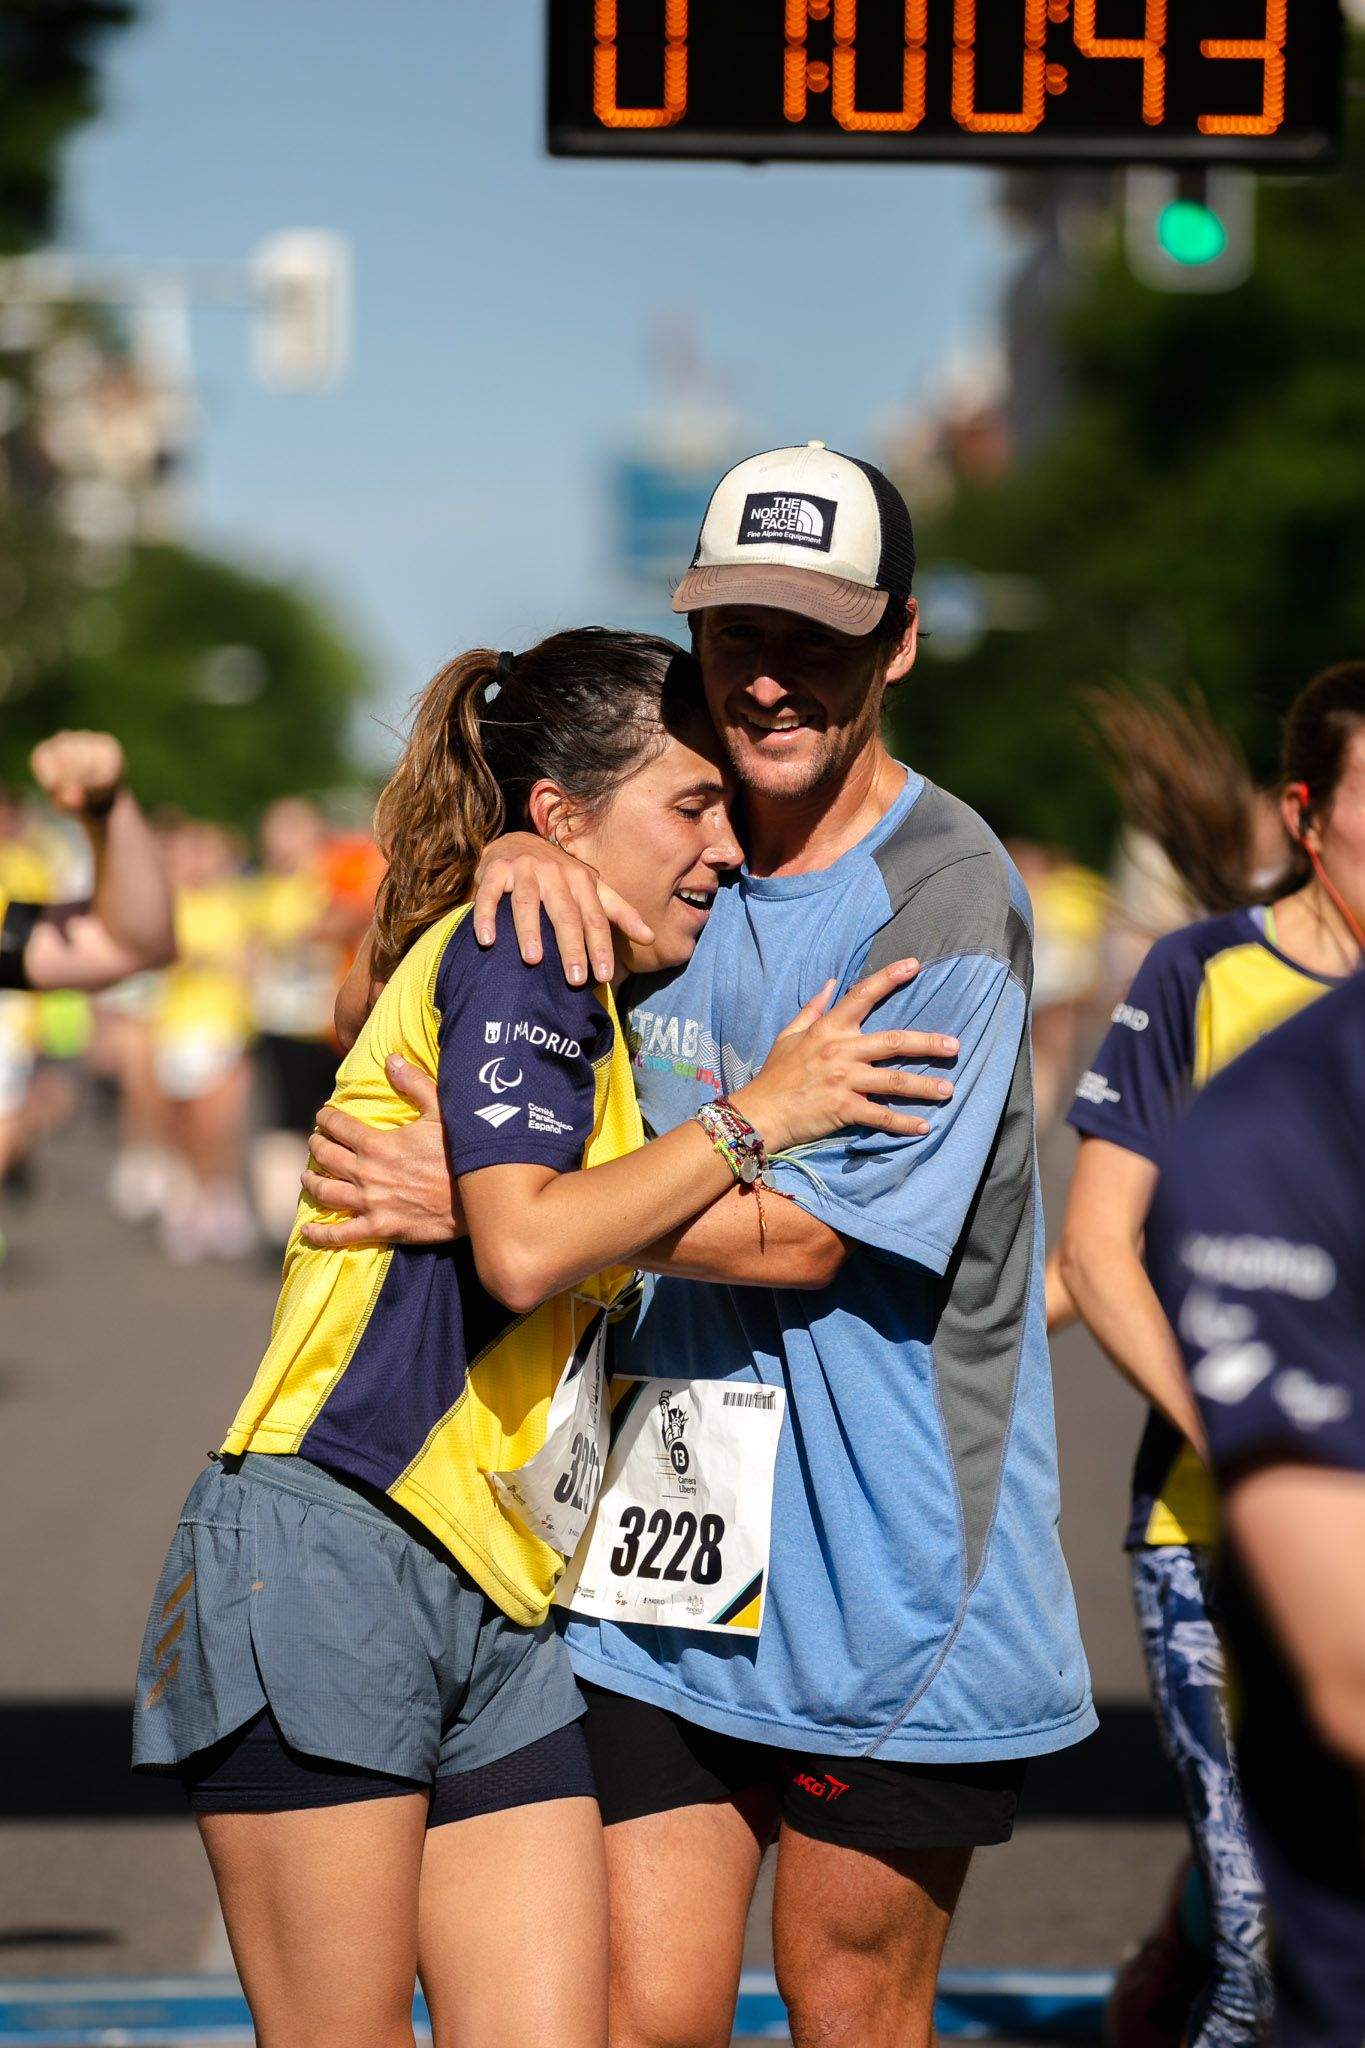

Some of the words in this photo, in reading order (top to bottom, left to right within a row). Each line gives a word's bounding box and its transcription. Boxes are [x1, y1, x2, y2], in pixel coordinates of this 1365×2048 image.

[773, 497, 801, 509] THE
[750, 507, 799, 520] NORTH
[760, 518, 797, 531] FACE
[762, 530, 783, 538] Alpine
[784, 531, 822, 544] Equipment
[513, 1021, 581, 1058] MADRID
[673, 1449, 686, 1467] 13
[678, 1485, 697, 1497] Liberty
[610, 1506, 726, 1586] 3228
